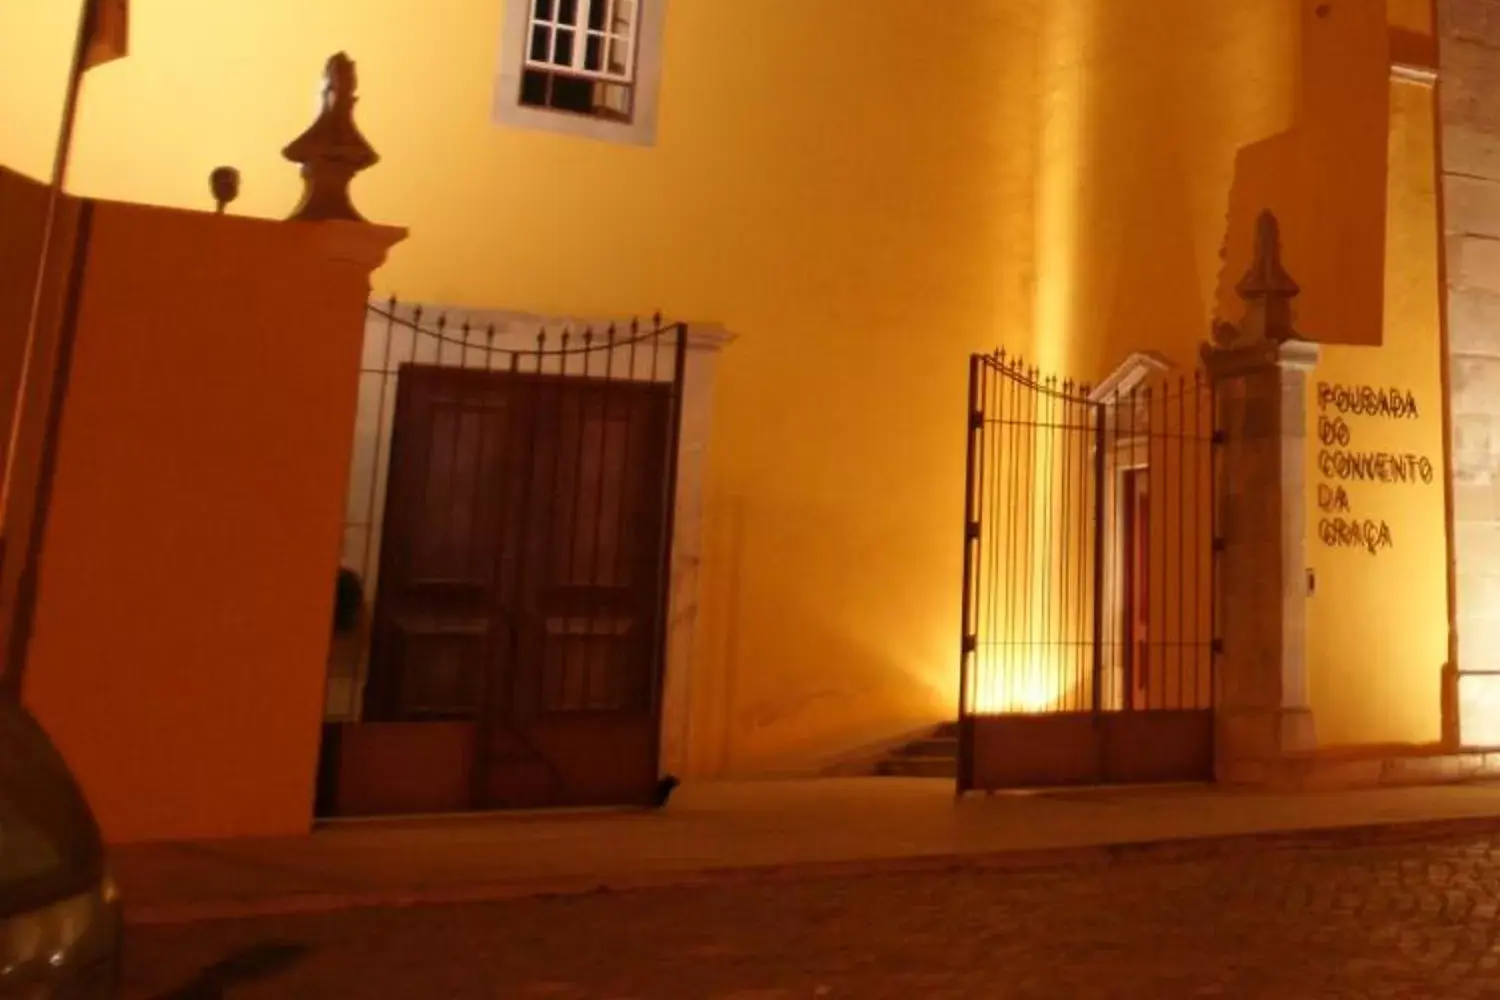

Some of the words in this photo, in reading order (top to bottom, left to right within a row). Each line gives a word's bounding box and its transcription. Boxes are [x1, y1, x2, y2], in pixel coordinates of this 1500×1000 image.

[1317, 381, 1418, 417] POUSADA
[1318, 416, 1350, 446] DO
[1318, 449, 1433, 485] CONVENTO
[1317, 483, 1350, 511] DA
[1319, 517, 1393, 555] GRAÇA
